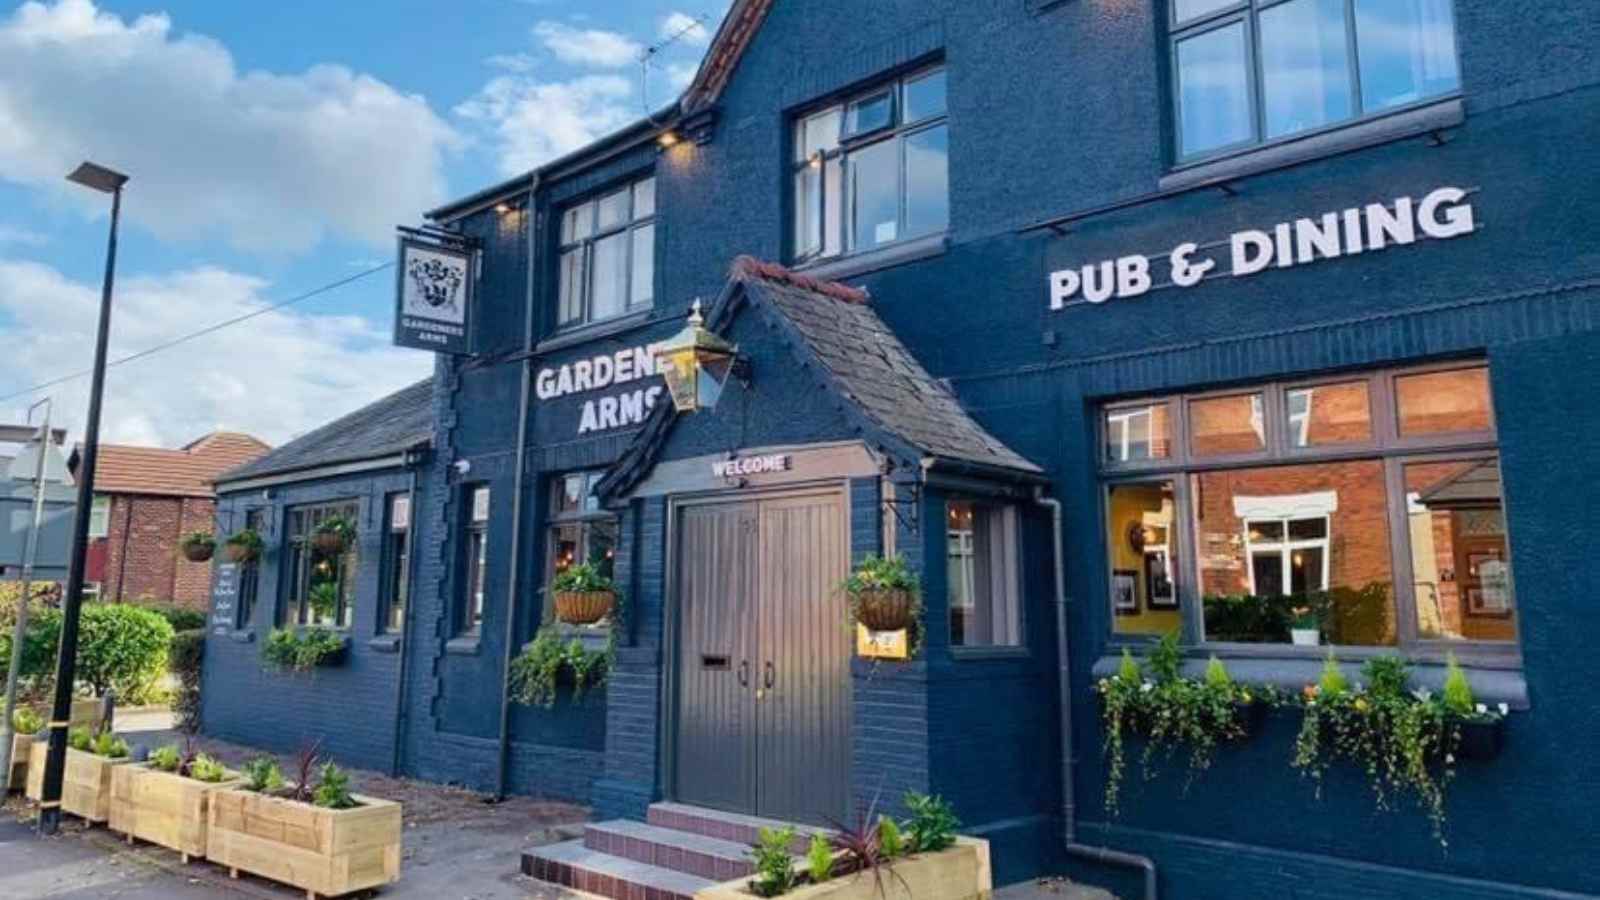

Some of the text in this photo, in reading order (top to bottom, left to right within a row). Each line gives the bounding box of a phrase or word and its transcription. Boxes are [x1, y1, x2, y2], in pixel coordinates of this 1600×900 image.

[1049, 186, 1475, 311] PUB & DINING
[402, 318, 464, 337] GARDENERS
[418, 331, 448, 344] ARMS
[711, 455, 786, 477] WELCOME
